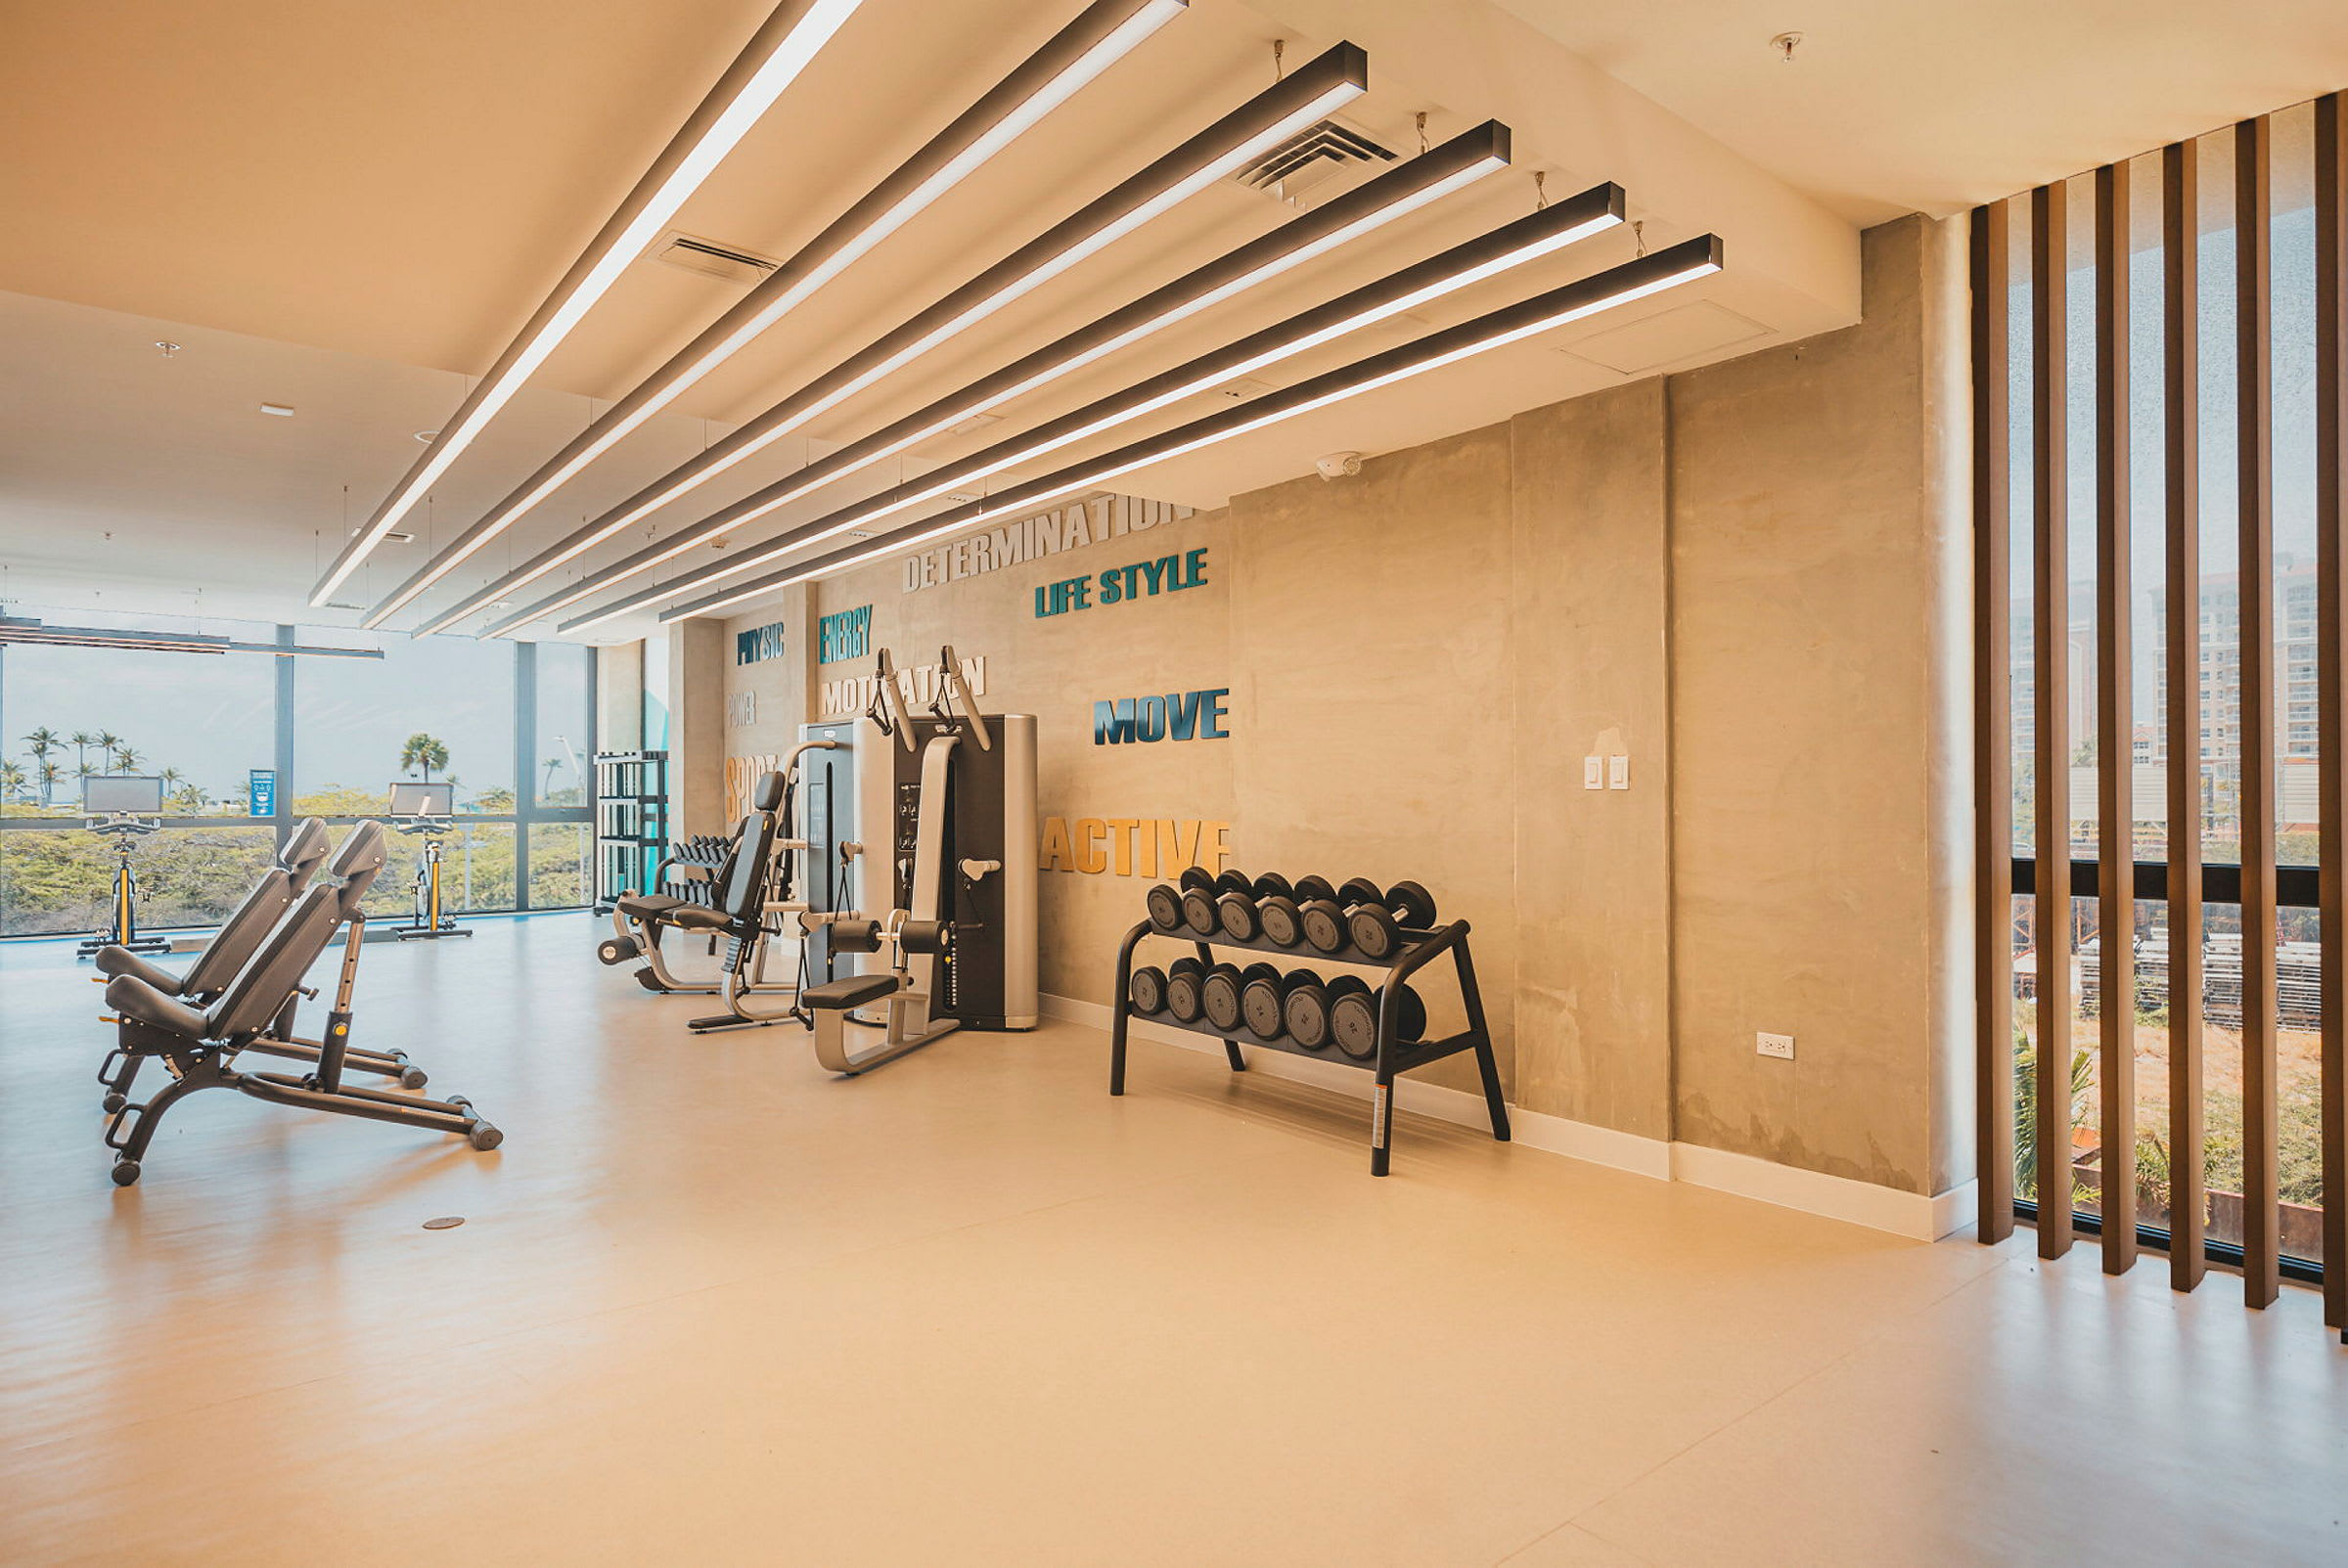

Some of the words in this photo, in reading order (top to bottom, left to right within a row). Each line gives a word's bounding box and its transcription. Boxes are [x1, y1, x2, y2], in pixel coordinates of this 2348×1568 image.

[1035, 575, 1091, 618] LIFE
[1100, 548, 1207, 604] STYLE
[737, 622, 784, 666] PHYSIC
[820, 604, 873, 665] ENERGY
[728, 690, 756, 728] POWER
[1094, 688, 1230, 745] MOVE
[1039, 817, 1230, 880] ACTIVE
